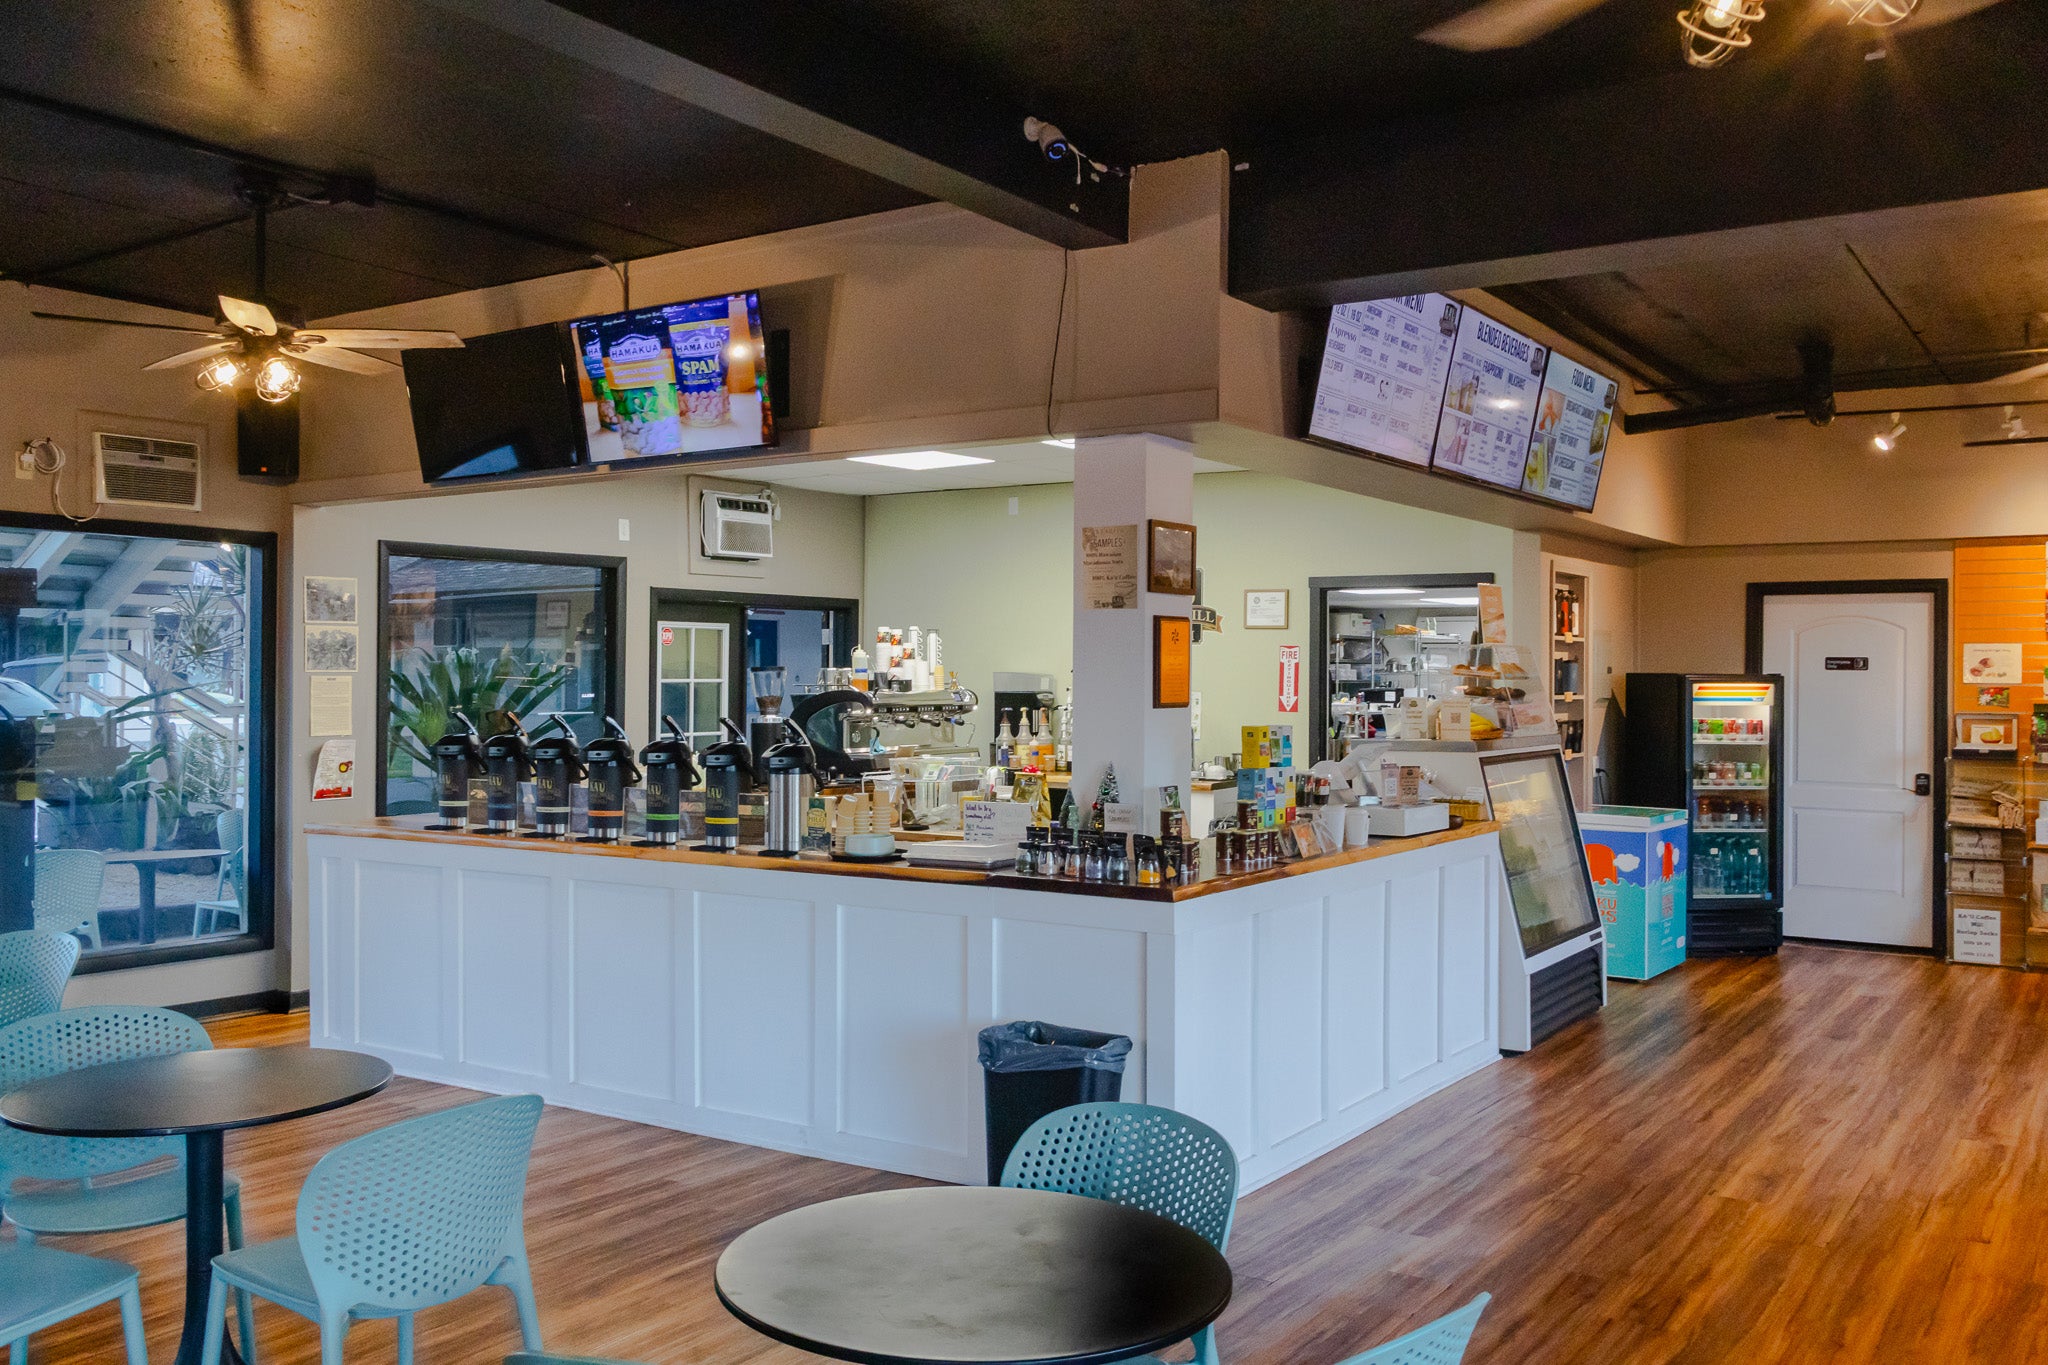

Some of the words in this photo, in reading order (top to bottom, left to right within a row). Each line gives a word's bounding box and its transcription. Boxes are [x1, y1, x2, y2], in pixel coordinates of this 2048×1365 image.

[1330, 322, 1357, 343] Espresso
[676, 340, 721, 352] HAMAKUA
[1477, 320, 1502, 349] BLENDED
[1501, 333, 1530, 363] BEVERAGES
[611, 344, 659, 359] HAMAKUA
[681, 359, 720, 375] SPAM
[1571, 368, 1584, 388] FOOD
[1582, 373, 1596, 393] MENU
[1093, 537, 1123, 548] SAMPLES
[1281, 650, 1298, 660] FIRE
